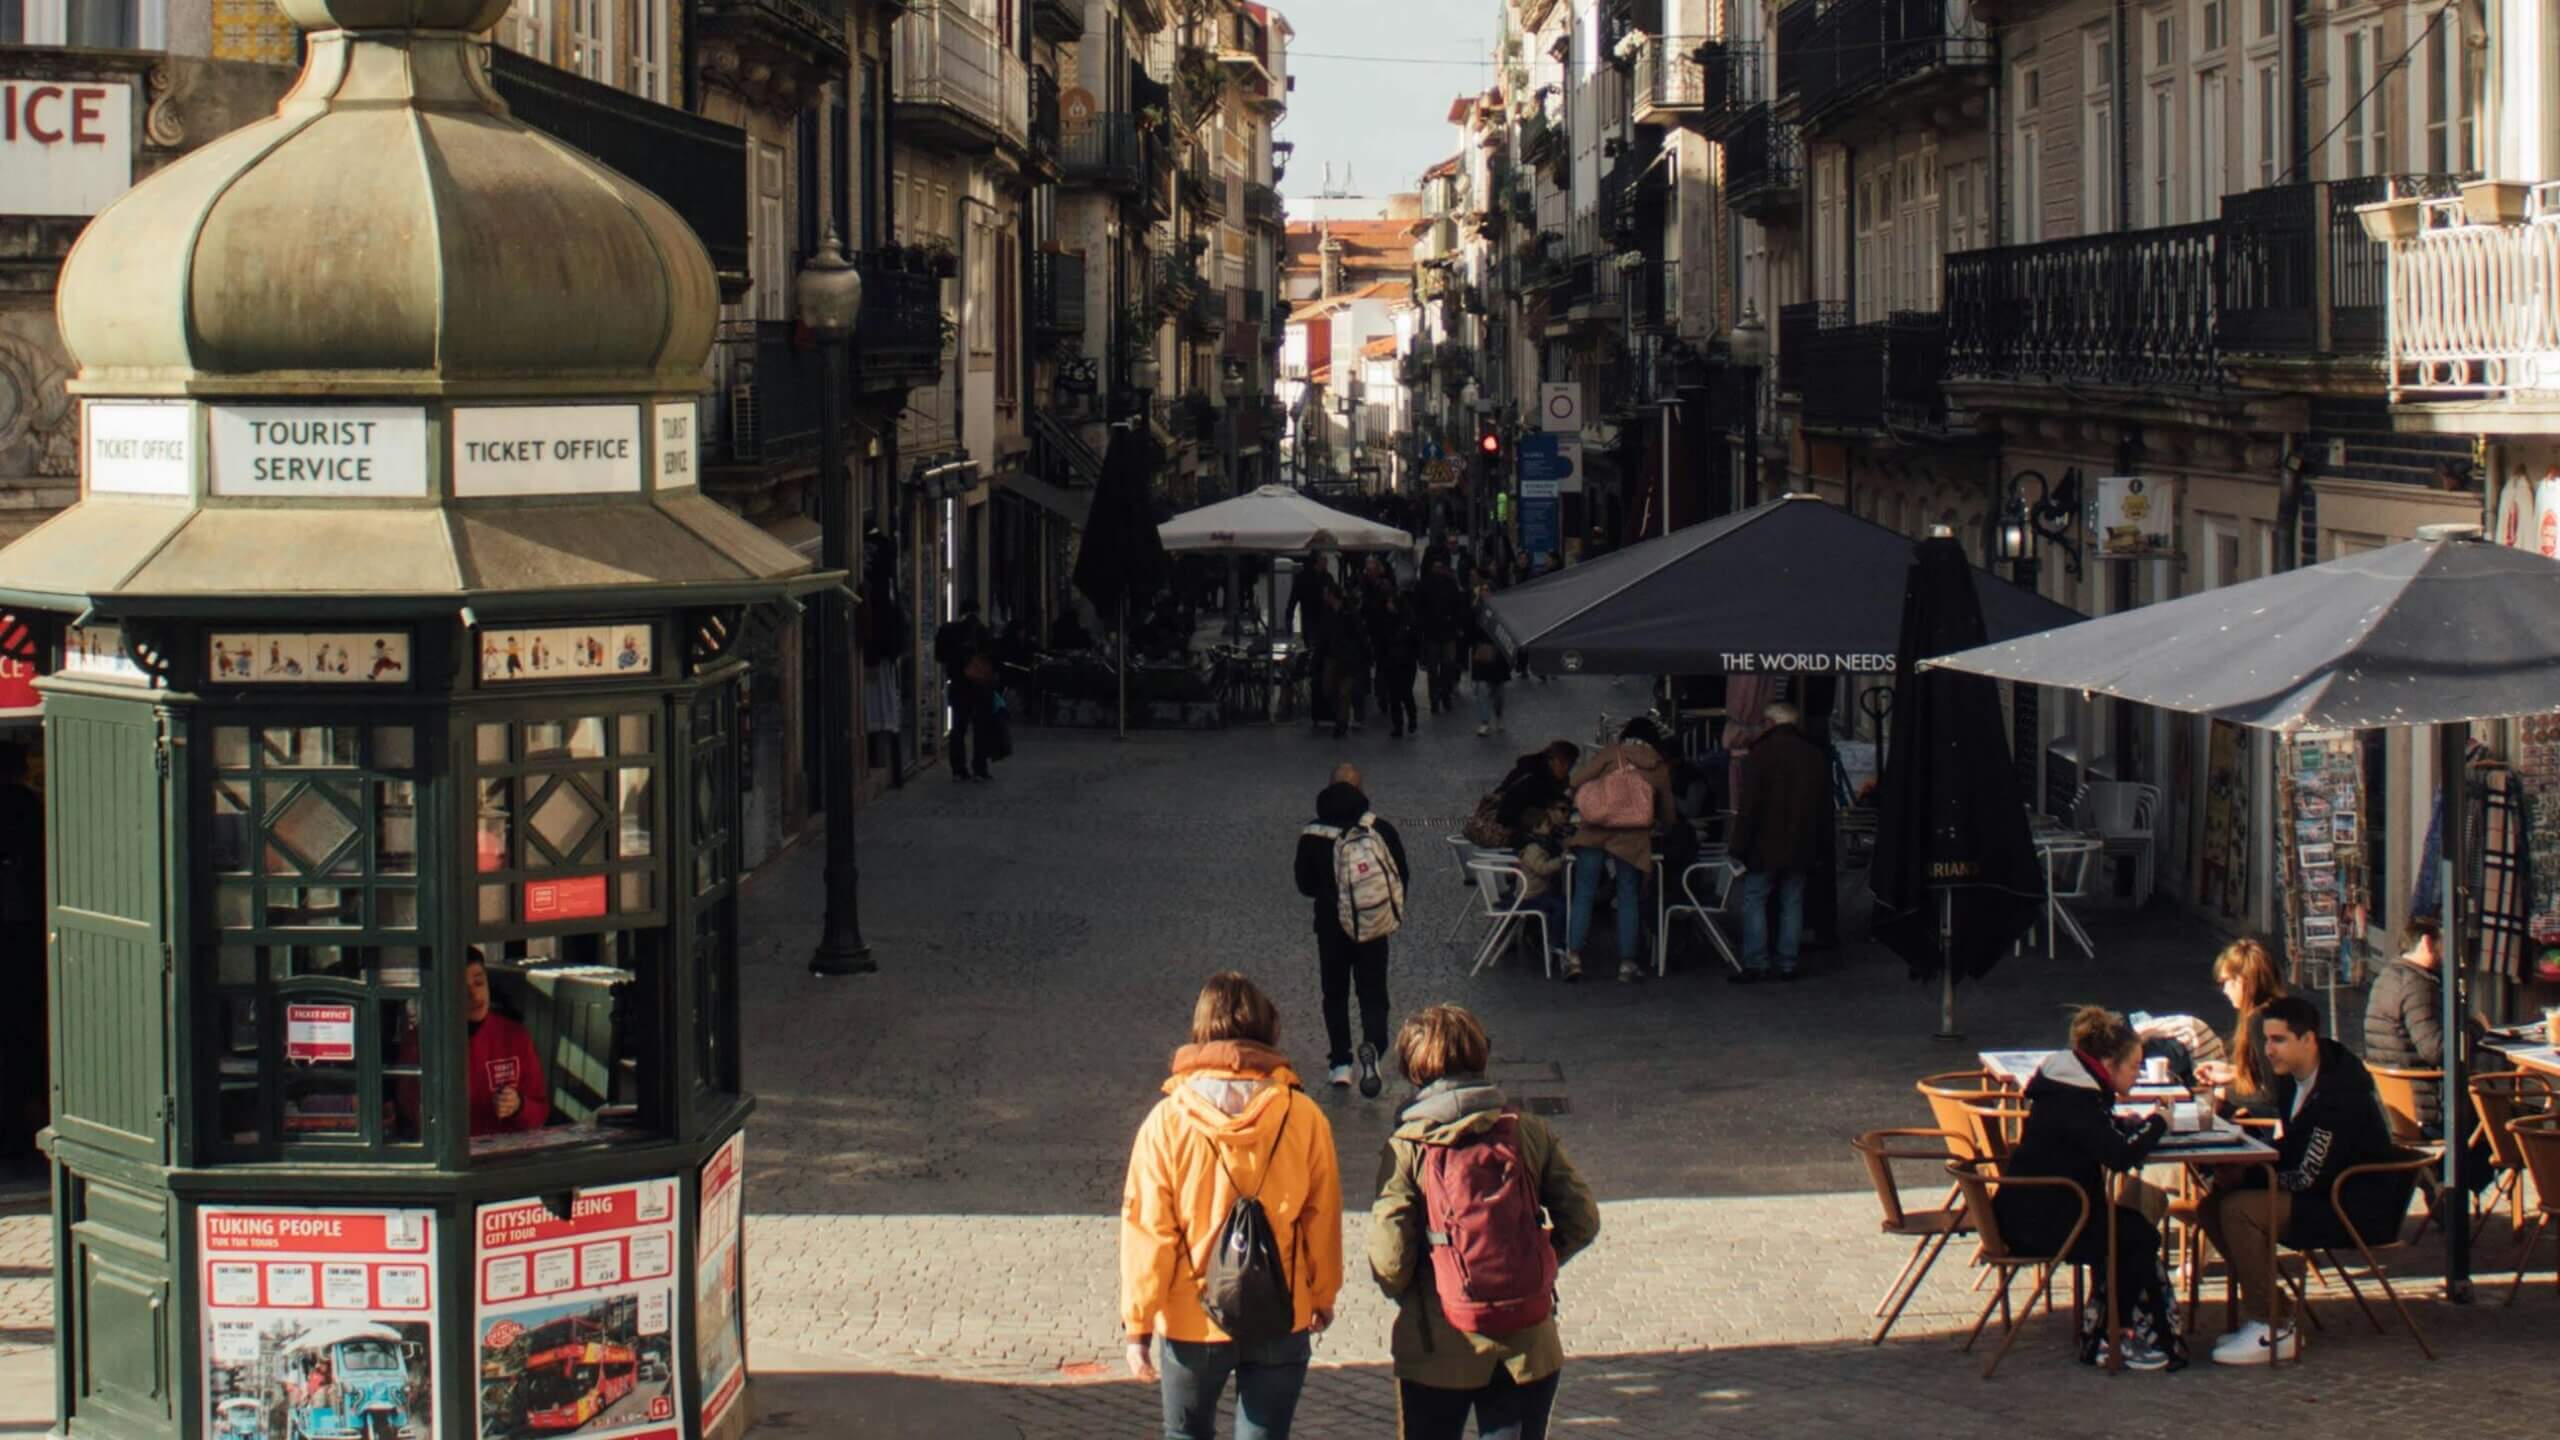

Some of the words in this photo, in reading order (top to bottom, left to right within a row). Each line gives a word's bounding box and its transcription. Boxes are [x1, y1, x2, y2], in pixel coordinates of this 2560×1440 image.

[249, 421, 377, 445] TOURIST
[662, 417, 688, 440] TOURIST
[96, 439, 138, 459] TICKET
[142, 439, 184, 461] OFFICE
[465, 441, 545, 462] TICKET
[553, 438, 629, 460] OFFICE
[254, 457, 372, 481] SERVICE
[663, 450, 688, 474] SERVICE
[1720, 653, 1754, 671] THE
[1759, 653, 1830, 671] WORLD
[1835, 653, 1897, 671] NEEDS
[321, 1011, 347, 1020] OFFICE
[209, 1218, 274, 1235] TUKING
[279, 1219, 343, 1236] PEOPLE
[485, 1232, 507, 1245] CITY
[510, 1227, 536, 1241] TOUR
[211, 1237, 229, 1247] TUK
[232, 1237, 249, 1247] TUK
[250, 1237, 279, 1248] TOURS
